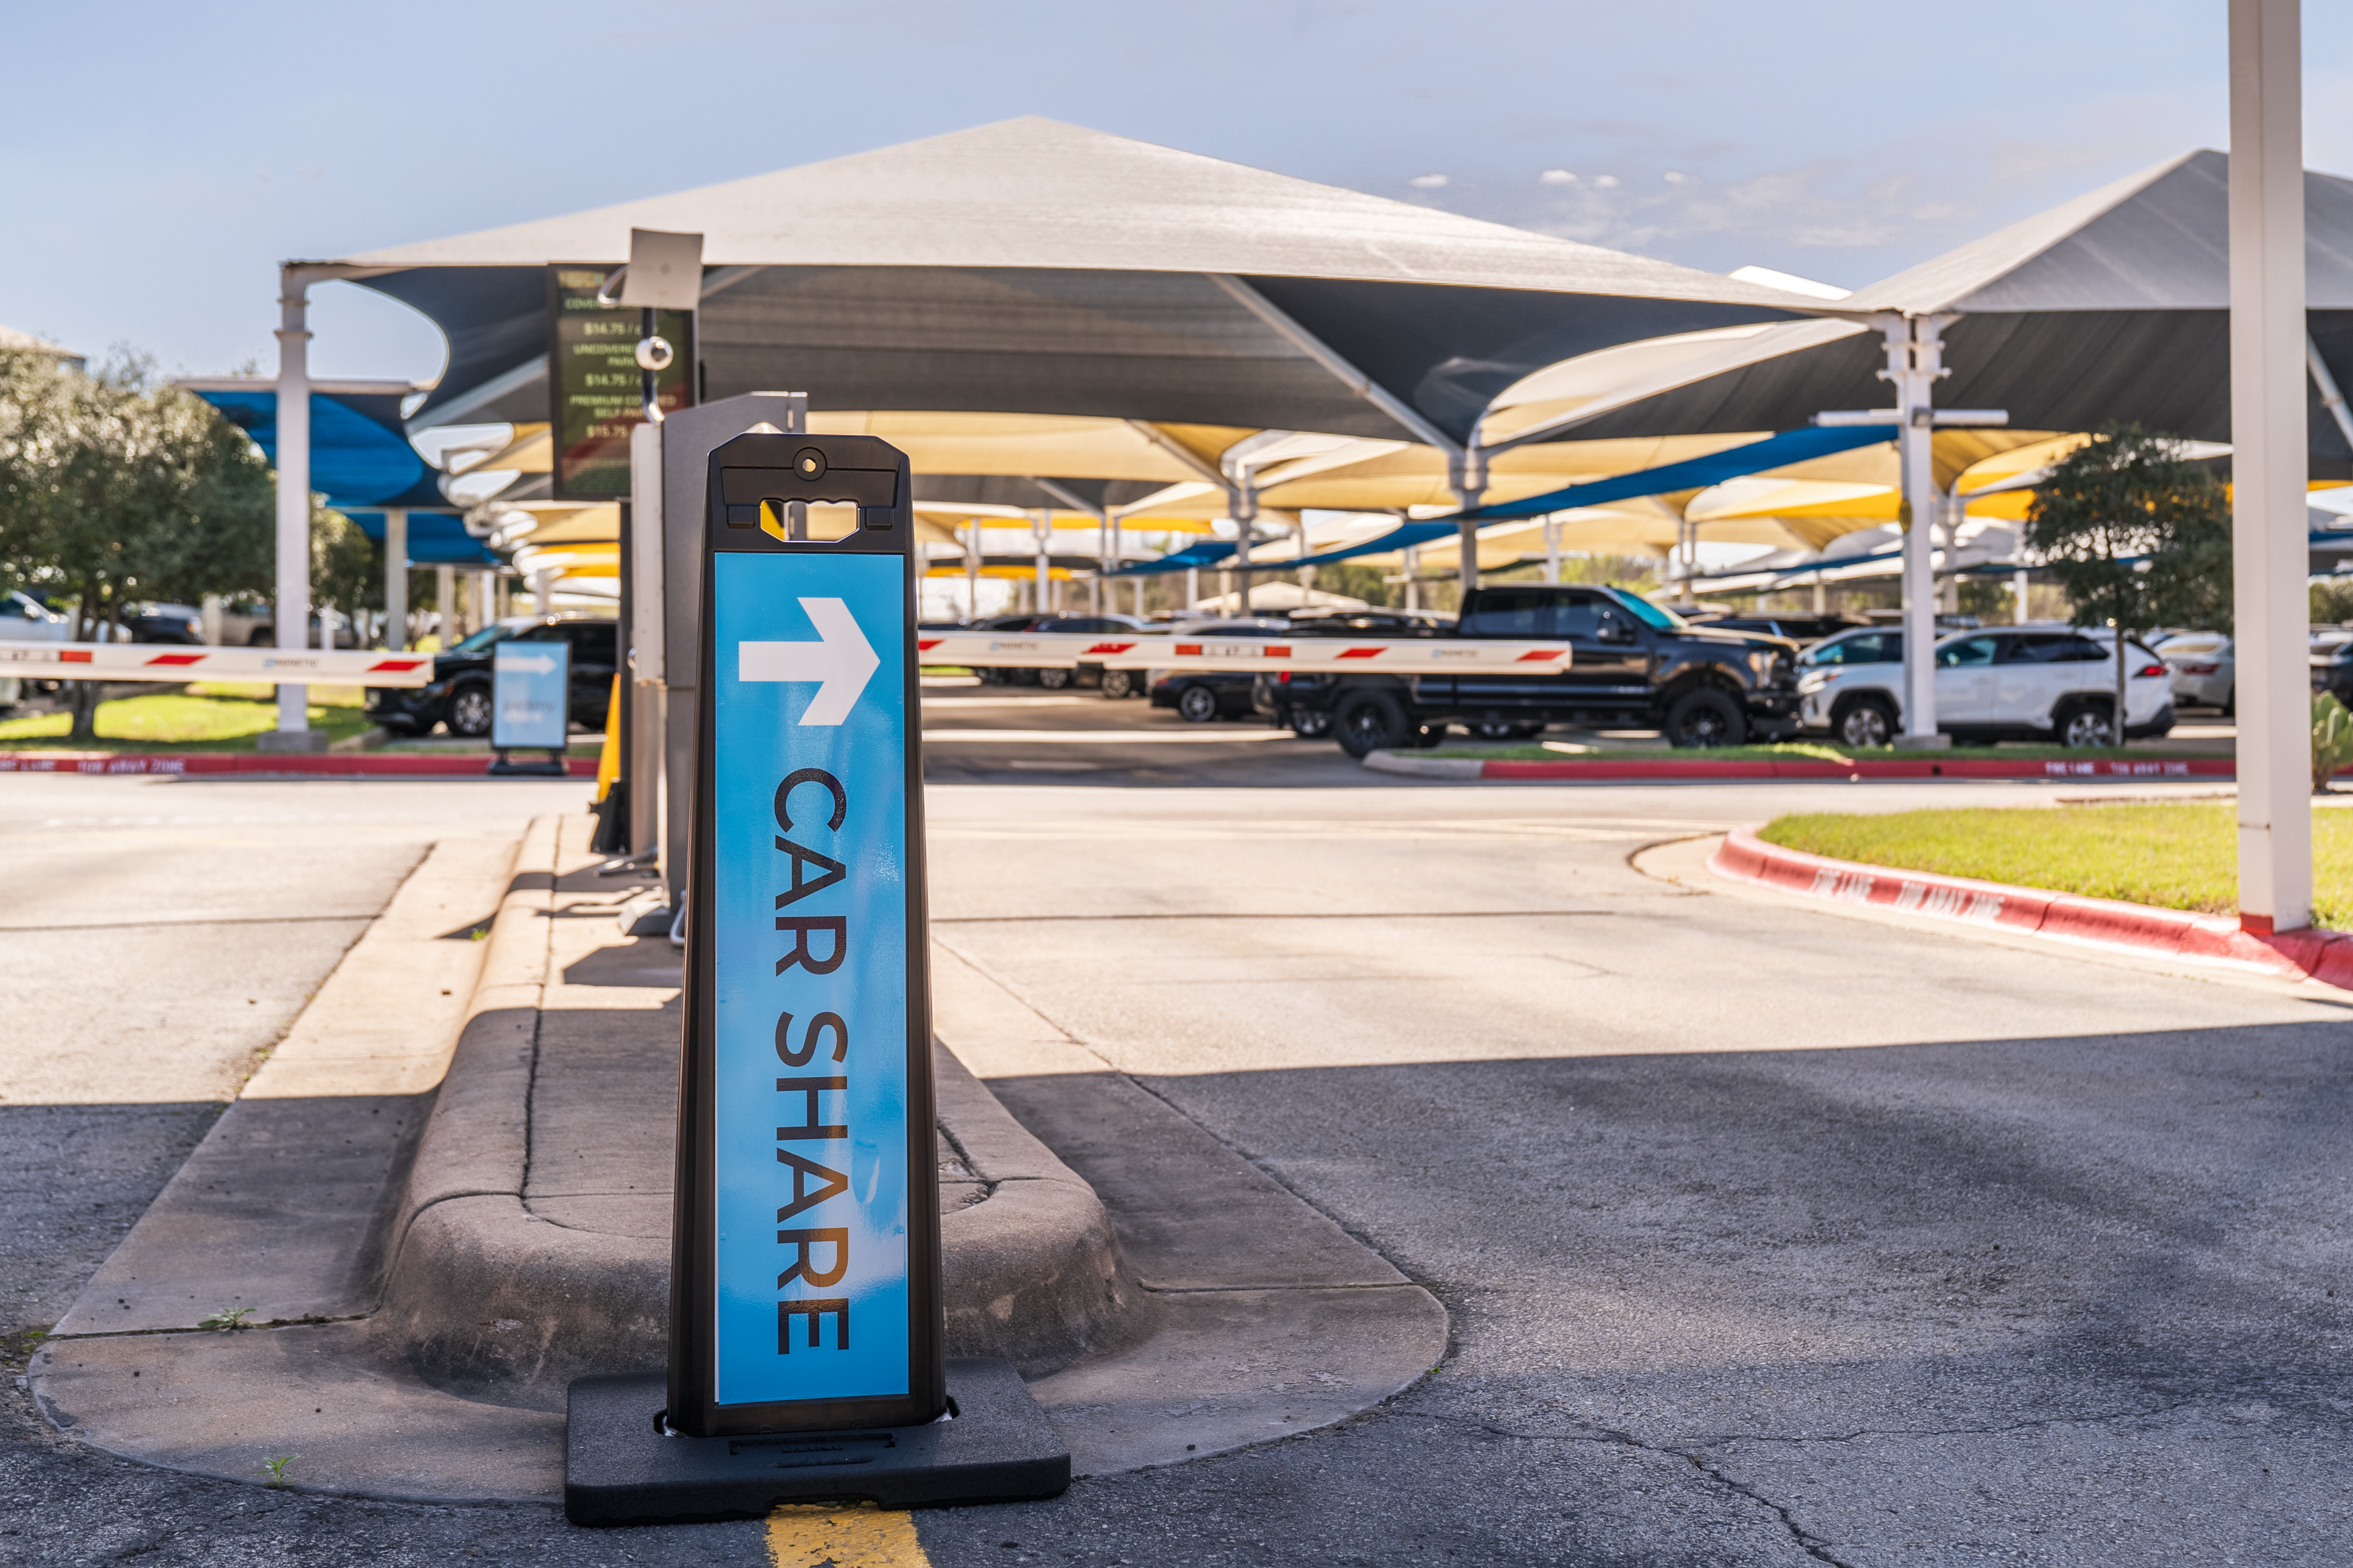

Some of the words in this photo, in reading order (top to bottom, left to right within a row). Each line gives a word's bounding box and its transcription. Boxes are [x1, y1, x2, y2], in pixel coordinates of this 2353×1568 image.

[569, 395, 624, 406] PREMIUM
[150, 759, 186, 774] ZONE
[774, 767, 847, 977] CAR
[775, 1011, 850, 1355] SHARE
